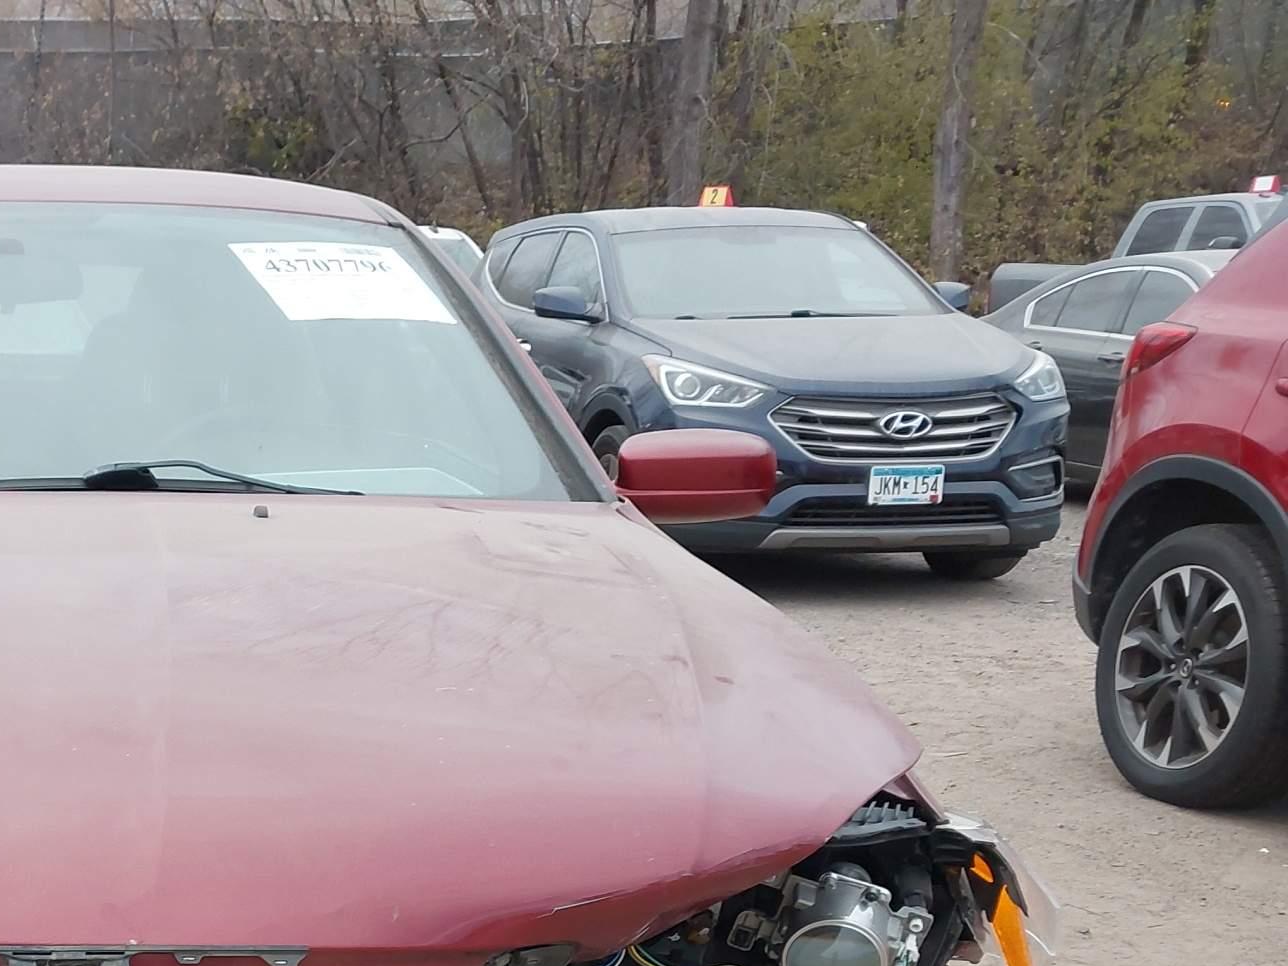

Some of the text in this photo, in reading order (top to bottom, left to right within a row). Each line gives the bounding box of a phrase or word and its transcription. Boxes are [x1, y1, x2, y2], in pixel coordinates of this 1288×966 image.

[709, 188, 719, 205] 2
[874, 475, 939, 496] JKM 154
